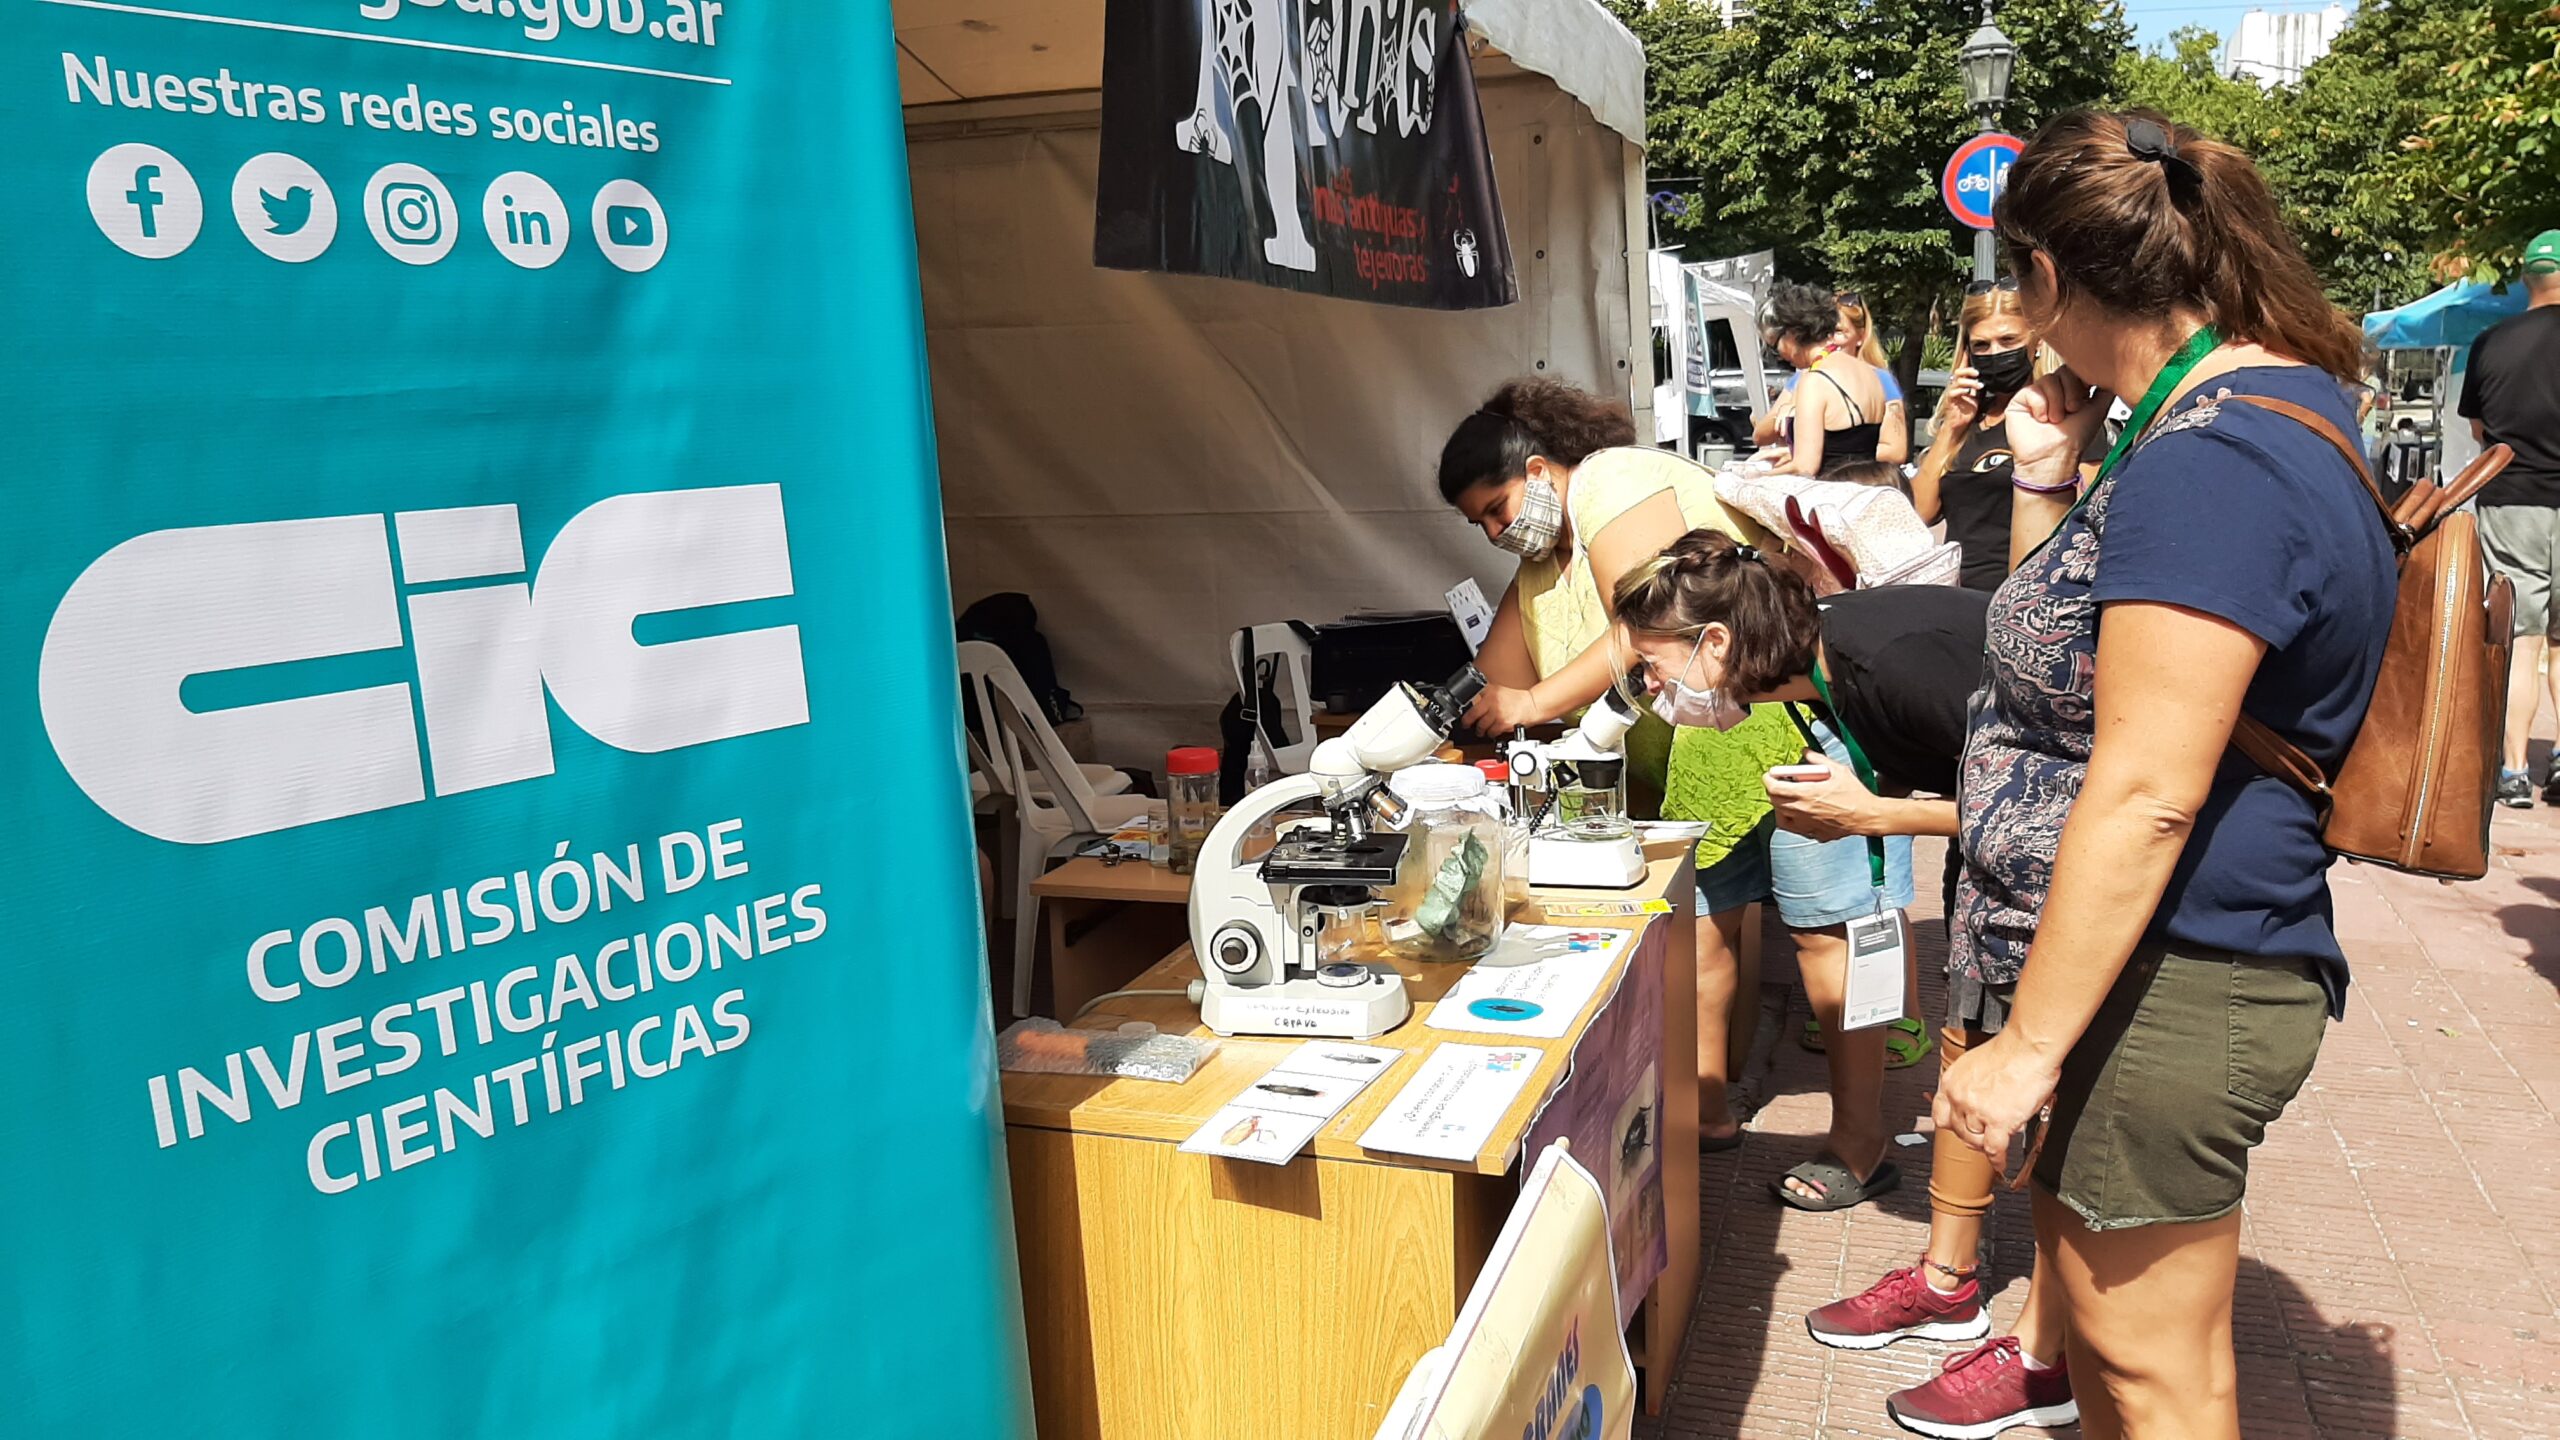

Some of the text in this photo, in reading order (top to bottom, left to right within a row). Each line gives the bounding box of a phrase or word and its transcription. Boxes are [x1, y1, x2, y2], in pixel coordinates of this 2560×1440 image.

[61, 52, 660, 153] Nuestras redes sociales
[245, 818, 749, 1003] COMISIÓN DE
[146, 884, 828, 1149] INVESTIGACIONES
[306, 990, 751, 1194] CIENTÍFICAS
